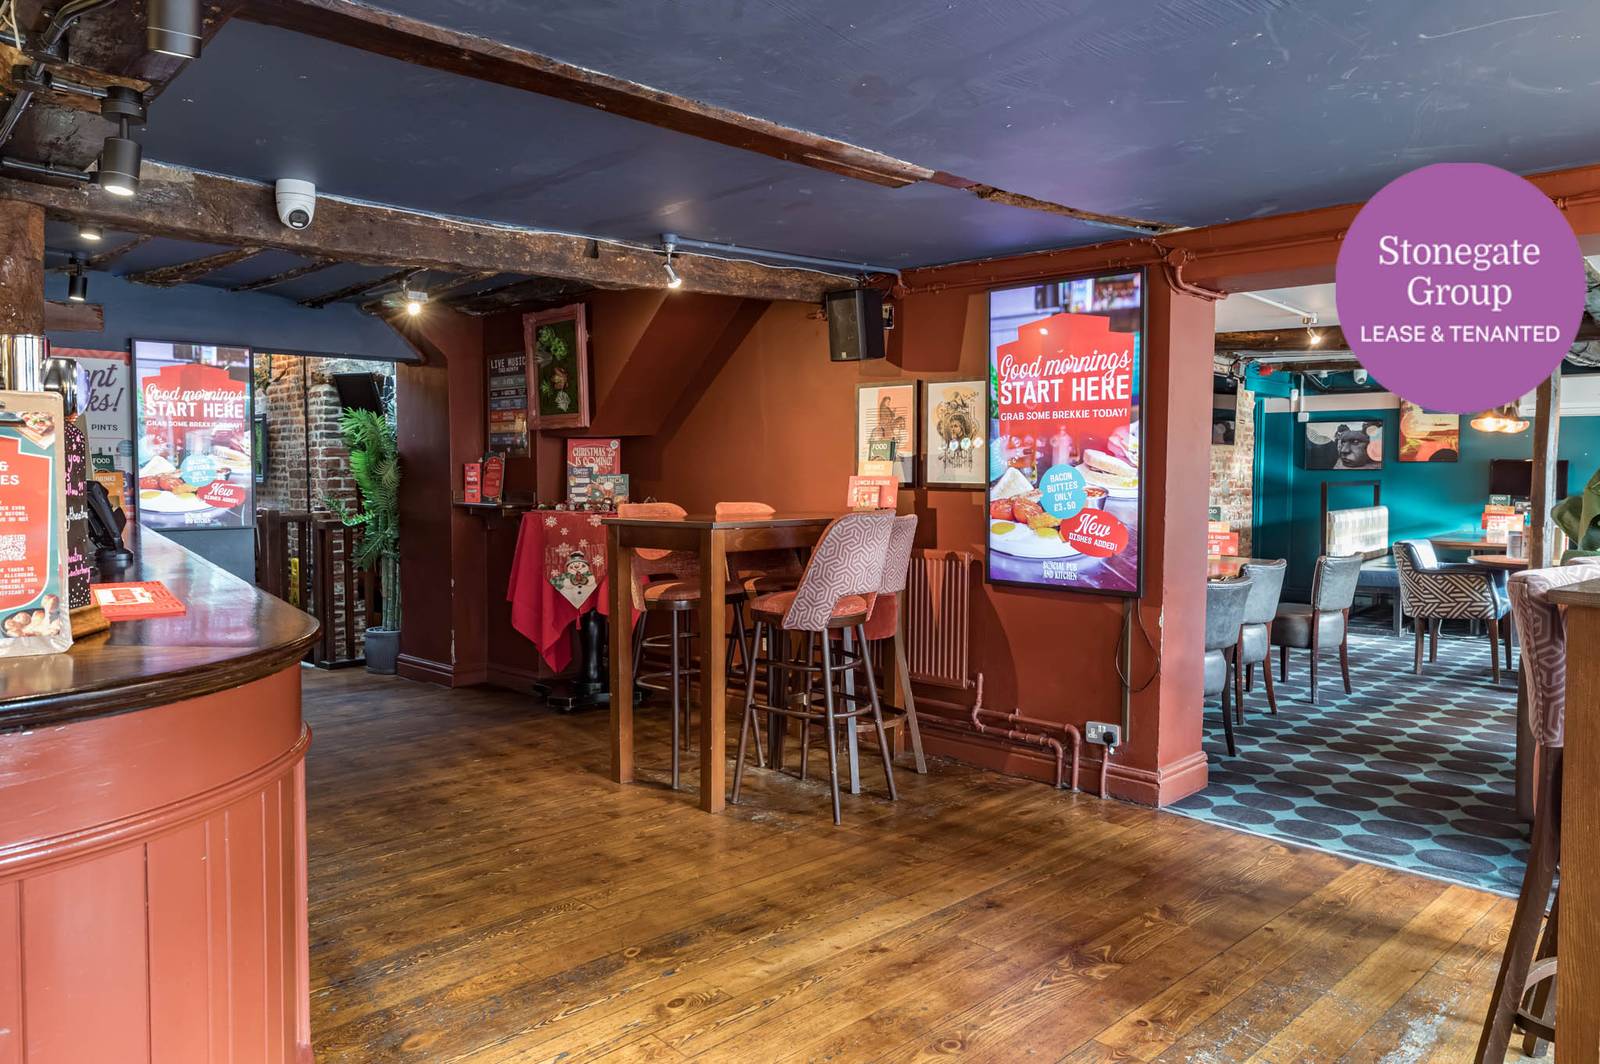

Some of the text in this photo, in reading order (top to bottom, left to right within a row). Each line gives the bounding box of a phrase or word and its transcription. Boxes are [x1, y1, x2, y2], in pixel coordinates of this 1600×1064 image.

[490, 359, 505, 369] LIVE
[1000, 354, 1042, 383] Good
[145, 383, 181, 403] Good
[1001, 375, 1129, 405] START HERE
[146, 401, 244, 418] START HERE
[1000, 408, 1128, 421] GRAB SOME BREKKIE TODAY!
[573, 447, 606, 457] CHRISTMAS
[92, 456, 111, 464] FOOD
[1049, 472, 1073, 483] BACON
[208, 482, 234, 497] New
[1046, 480, 1079, 494] BUTTIES
[1053, 491, 1073, 502] ONLY
[1074, 513, 1111, 538] New
[1068, 532, 1118, 552] DISHES ADDED!
